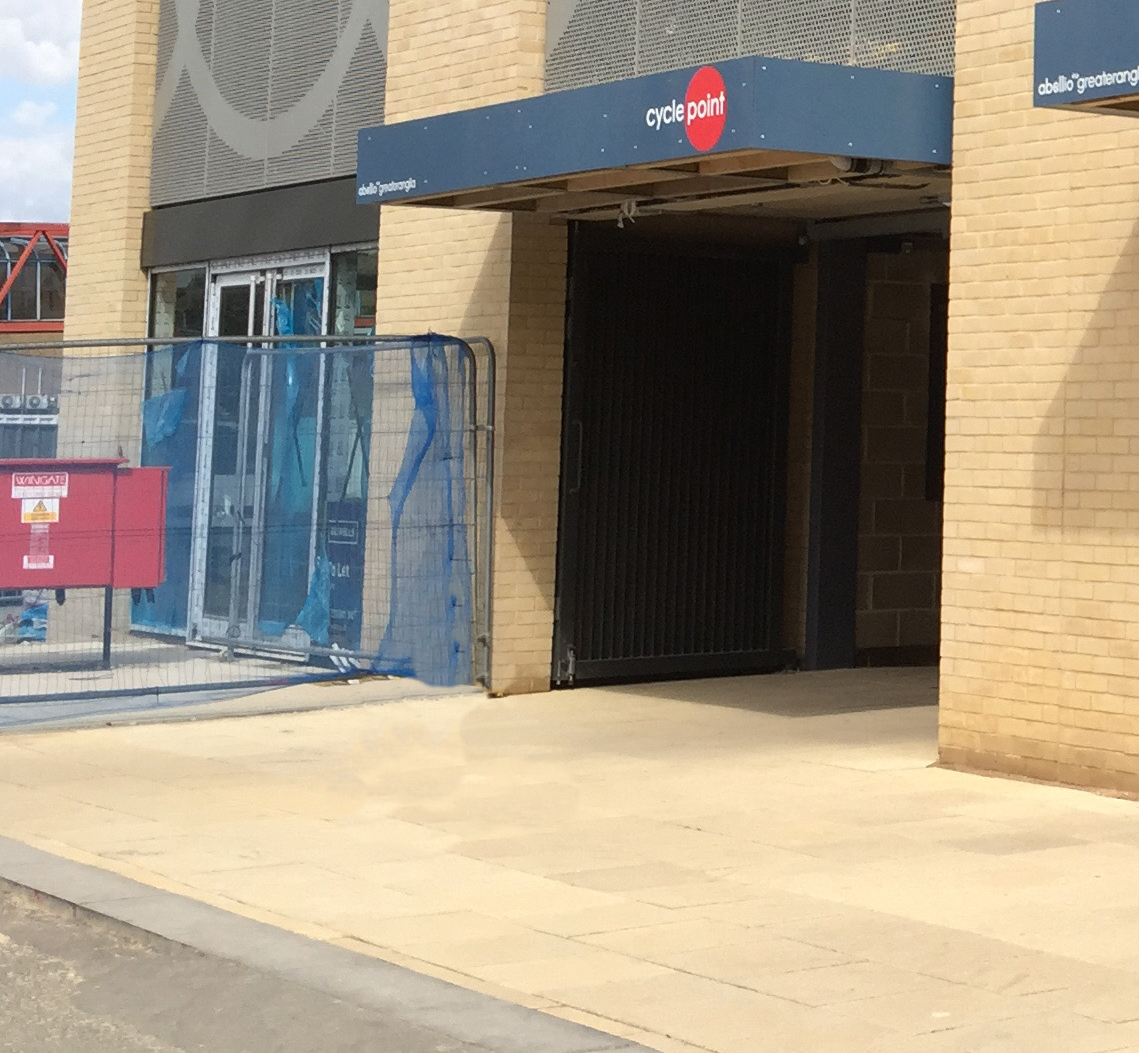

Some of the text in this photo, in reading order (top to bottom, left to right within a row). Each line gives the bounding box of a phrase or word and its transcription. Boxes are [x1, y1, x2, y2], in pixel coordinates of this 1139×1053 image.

[645, 91, 727, 131] cycle point
[15, 475, 66, 486] WINGATE
